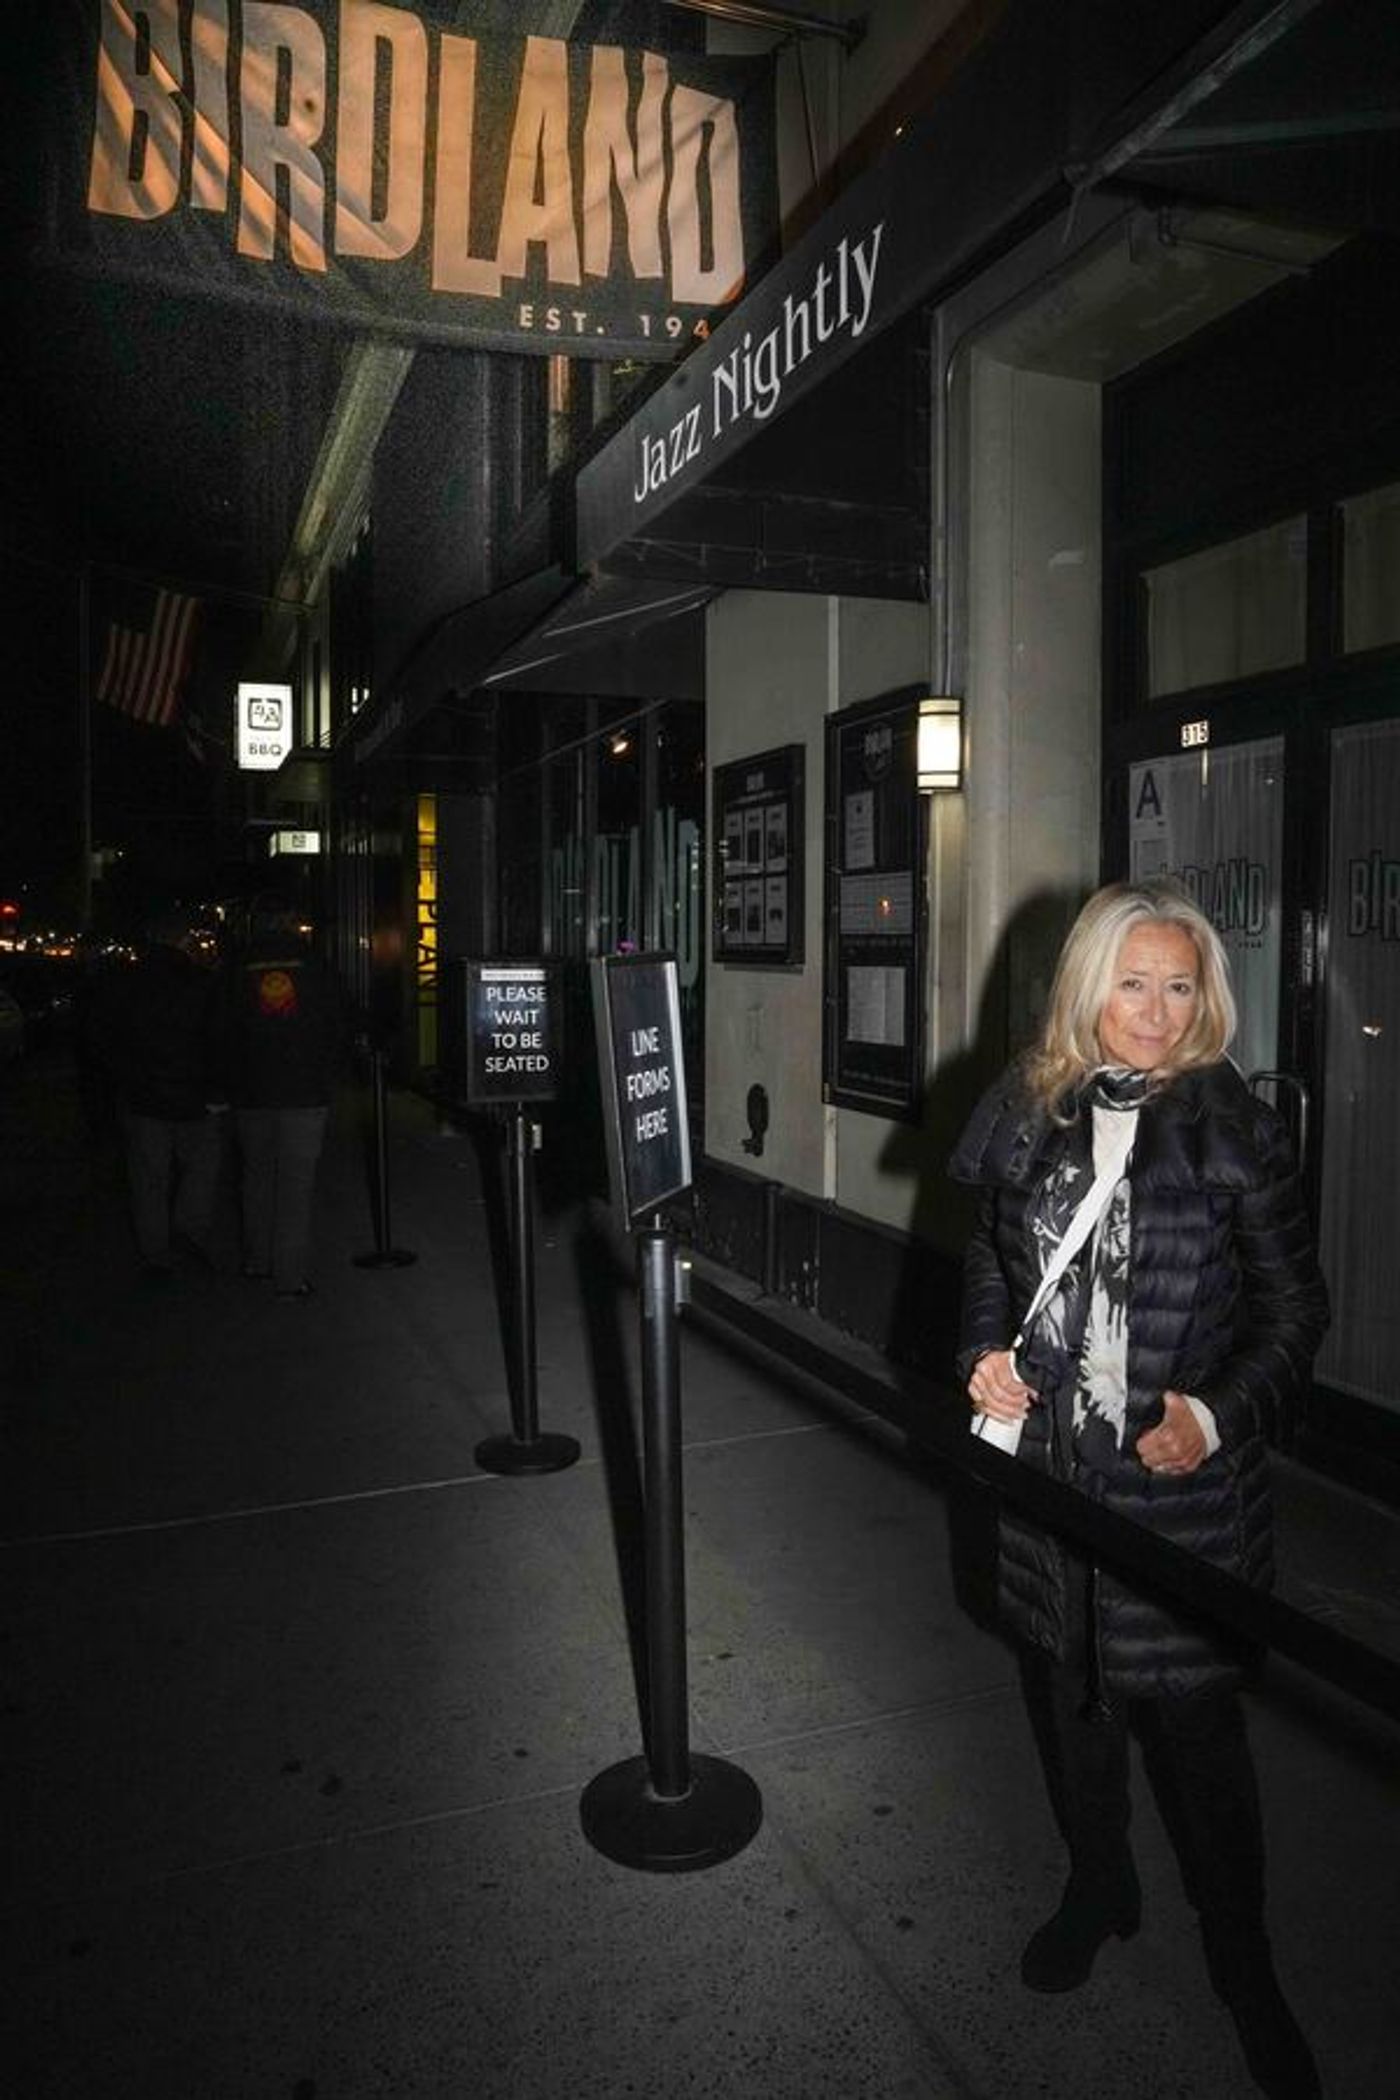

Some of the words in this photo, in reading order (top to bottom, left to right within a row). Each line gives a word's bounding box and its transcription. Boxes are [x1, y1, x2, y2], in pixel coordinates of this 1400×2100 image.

[88, 0, 746, 304] BIRDLAND
[519, 304, 605, 334] EST.
[635, 405, 701, 503] Jazz
[712, 221, 883, 438] Nightly
[248, 743, 283, 757] BBQ
[1136, 770, 1162, 818] A
[485, 986, 547, 1002] PLEASE
[494, 1009, 540, 1025] WAIT
[491, 1032, 517, 1049] TO
[520, 1033, 542, 1049] BE
[632, 1026, 660, 1057] LINE
[485, 1055, 550, 1073] SEATED
[625, 1065, 671, 1101] FORMS
[636, 1108, 669, 1144] HERE
